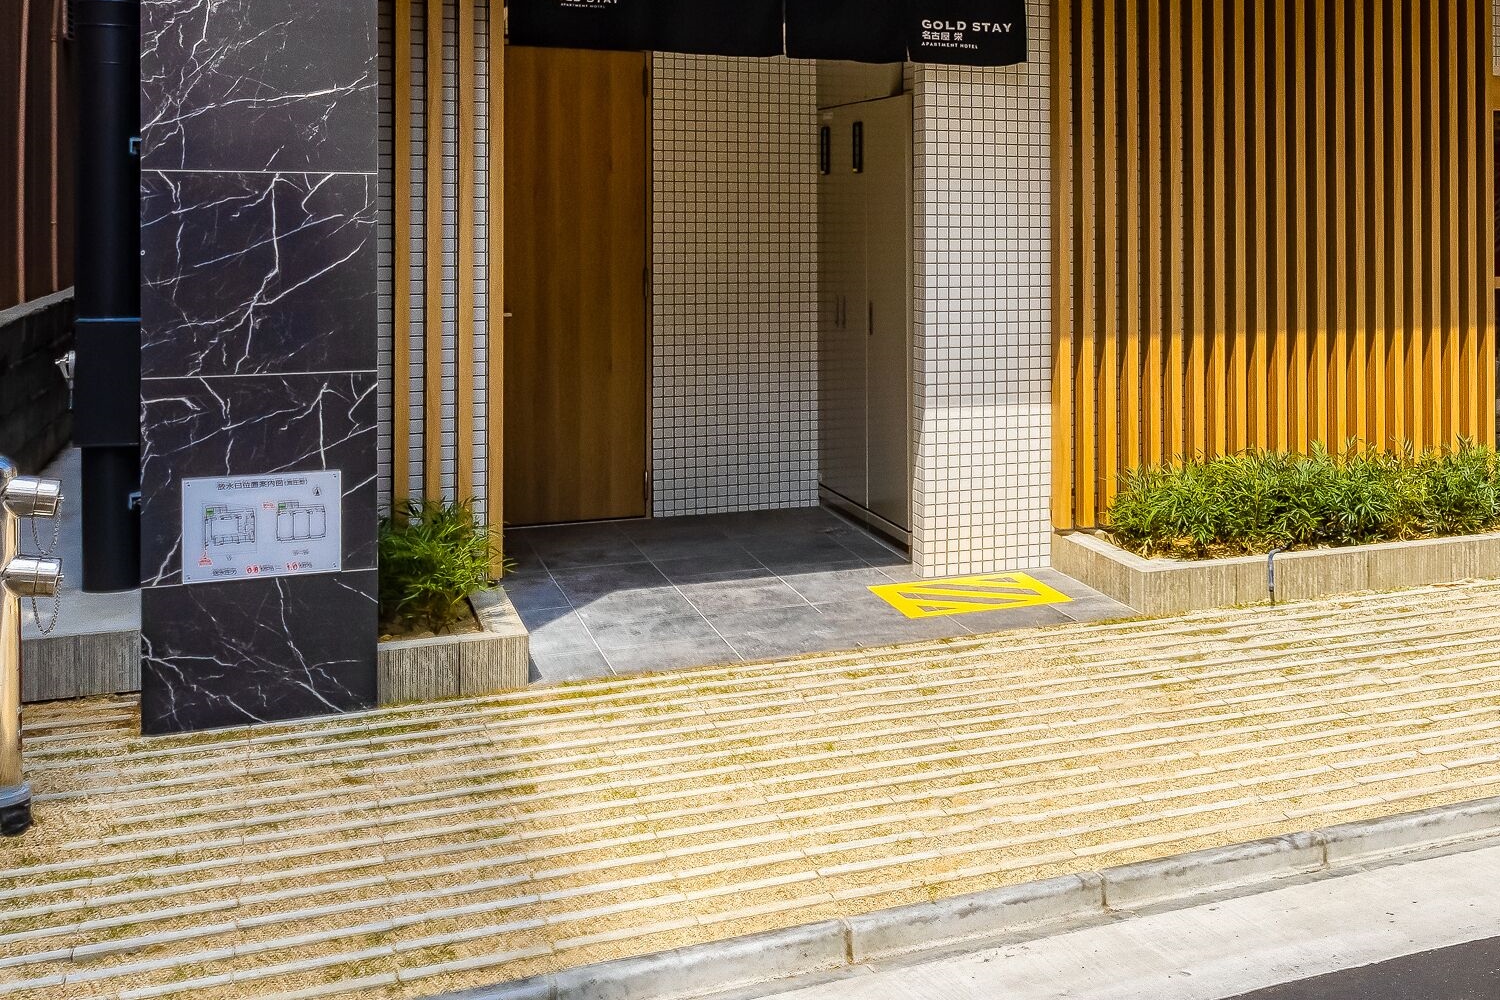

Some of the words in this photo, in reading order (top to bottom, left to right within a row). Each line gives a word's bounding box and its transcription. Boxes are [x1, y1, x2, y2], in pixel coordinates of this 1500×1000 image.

[921, 19, 967, 31] GOLD
[972, 22, 1012, 33] STAY
[921, 30, 950, 41] 名古屋
[953, 32, 963, 41] 栄
